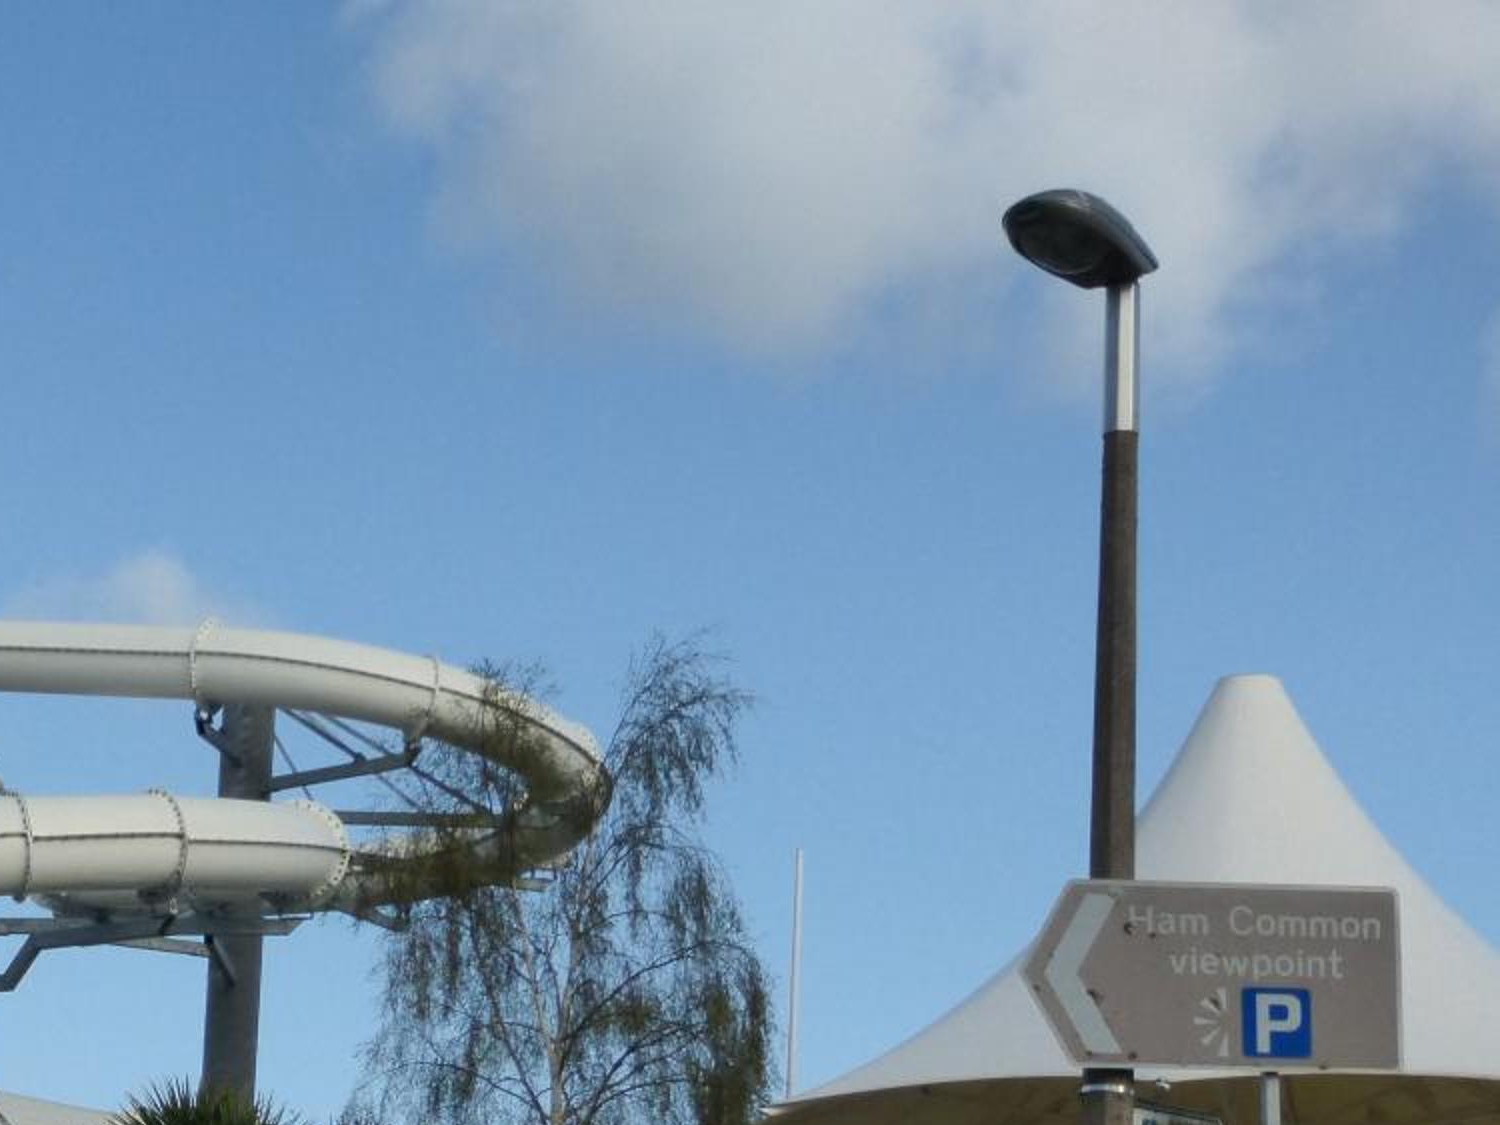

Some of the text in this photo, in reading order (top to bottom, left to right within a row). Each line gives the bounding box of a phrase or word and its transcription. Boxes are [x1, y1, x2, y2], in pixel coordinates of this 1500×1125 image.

[1128, 905, 1381, 940] Ham Common
[1170, 948, 1344, 979] viewpoint
[1255, 993, 1301, 1054] P
